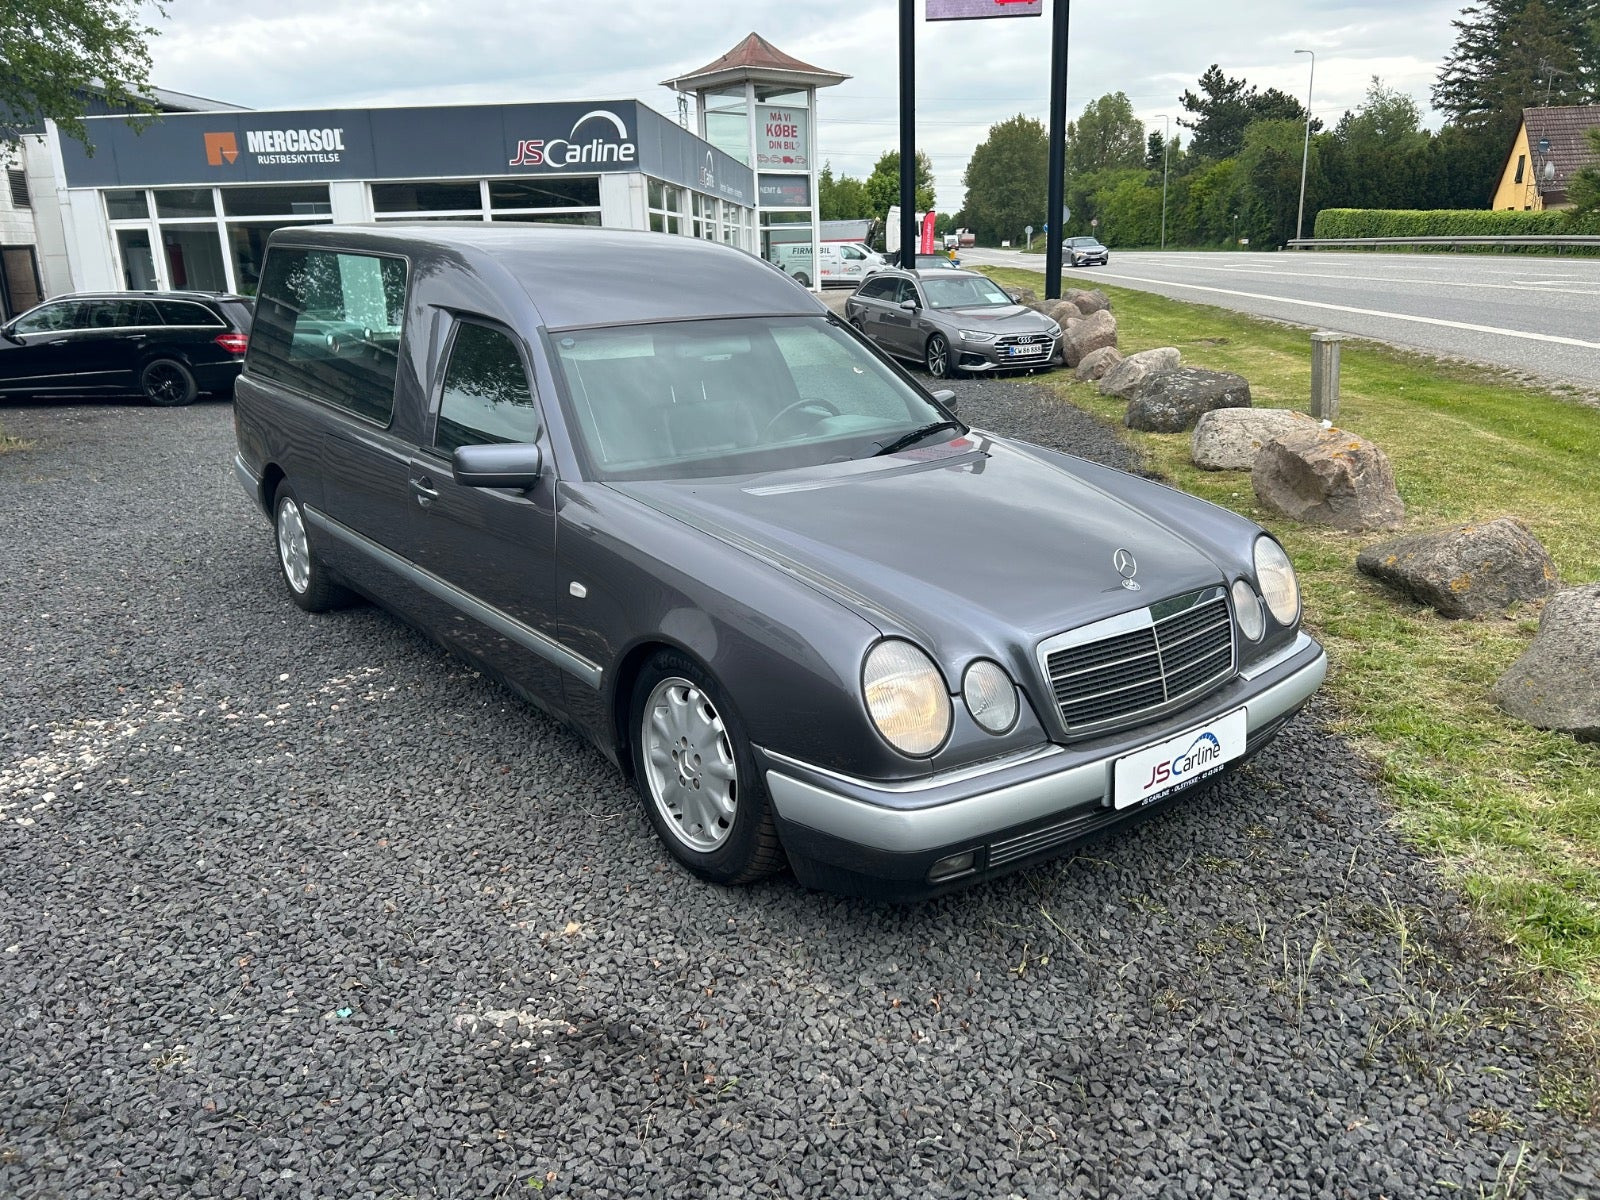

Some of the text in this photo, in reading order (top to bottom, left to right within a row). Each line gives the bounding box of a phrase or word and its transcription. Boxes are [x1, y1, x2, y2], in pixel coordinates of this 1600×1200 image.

[770, 111, 791, 122] MÅ VI
[766, 123, 798, 138] KØBE
[246, 128, 345, 153] MERCASOL
[769, 140, 782, 149] DIN
[257, 152, 341, 164] RUSTBESKYTTELSE
[760, 186, 776, 194] NEMT
[1148, 789, 1170, 803] CARLINE
